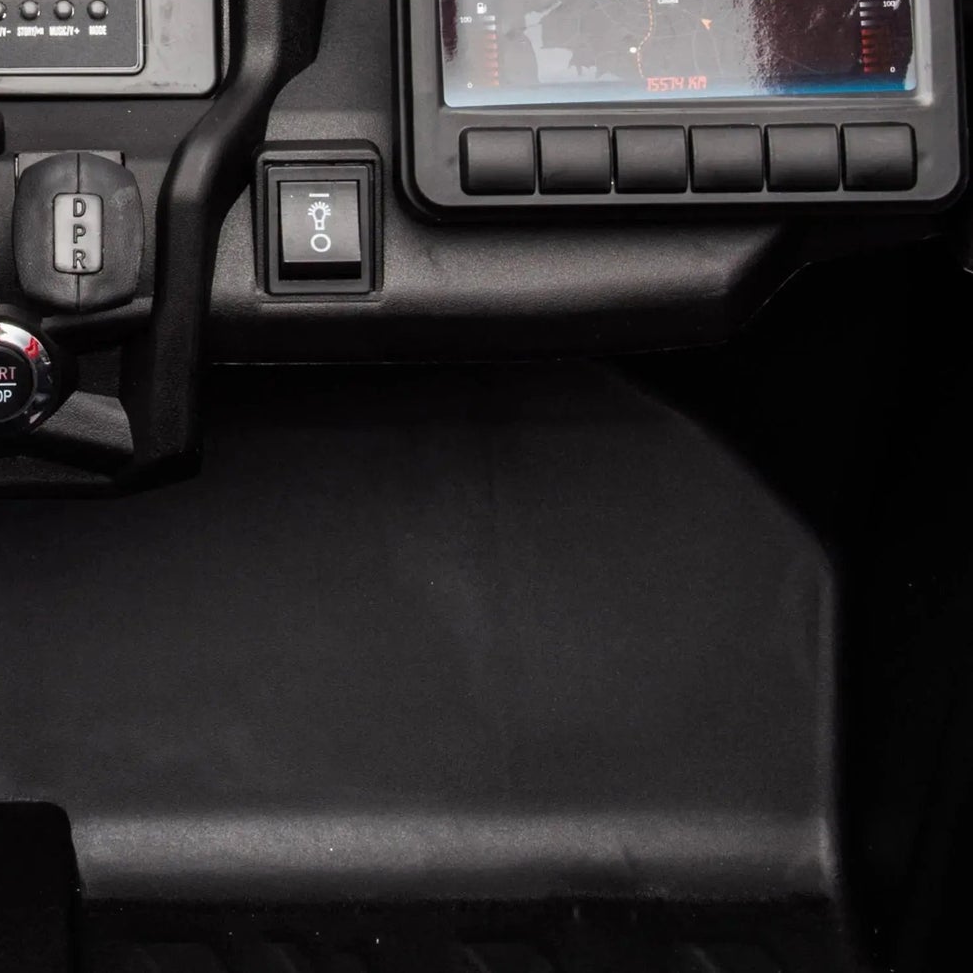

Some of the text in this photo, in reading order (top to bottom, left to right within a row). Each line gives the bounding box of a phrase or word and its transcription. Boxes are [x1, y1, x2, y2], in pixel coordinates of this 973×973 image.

[73, 197, 87, 218] D
[73, 224, 87, 244] P
[73, 248, 87, 269] R
